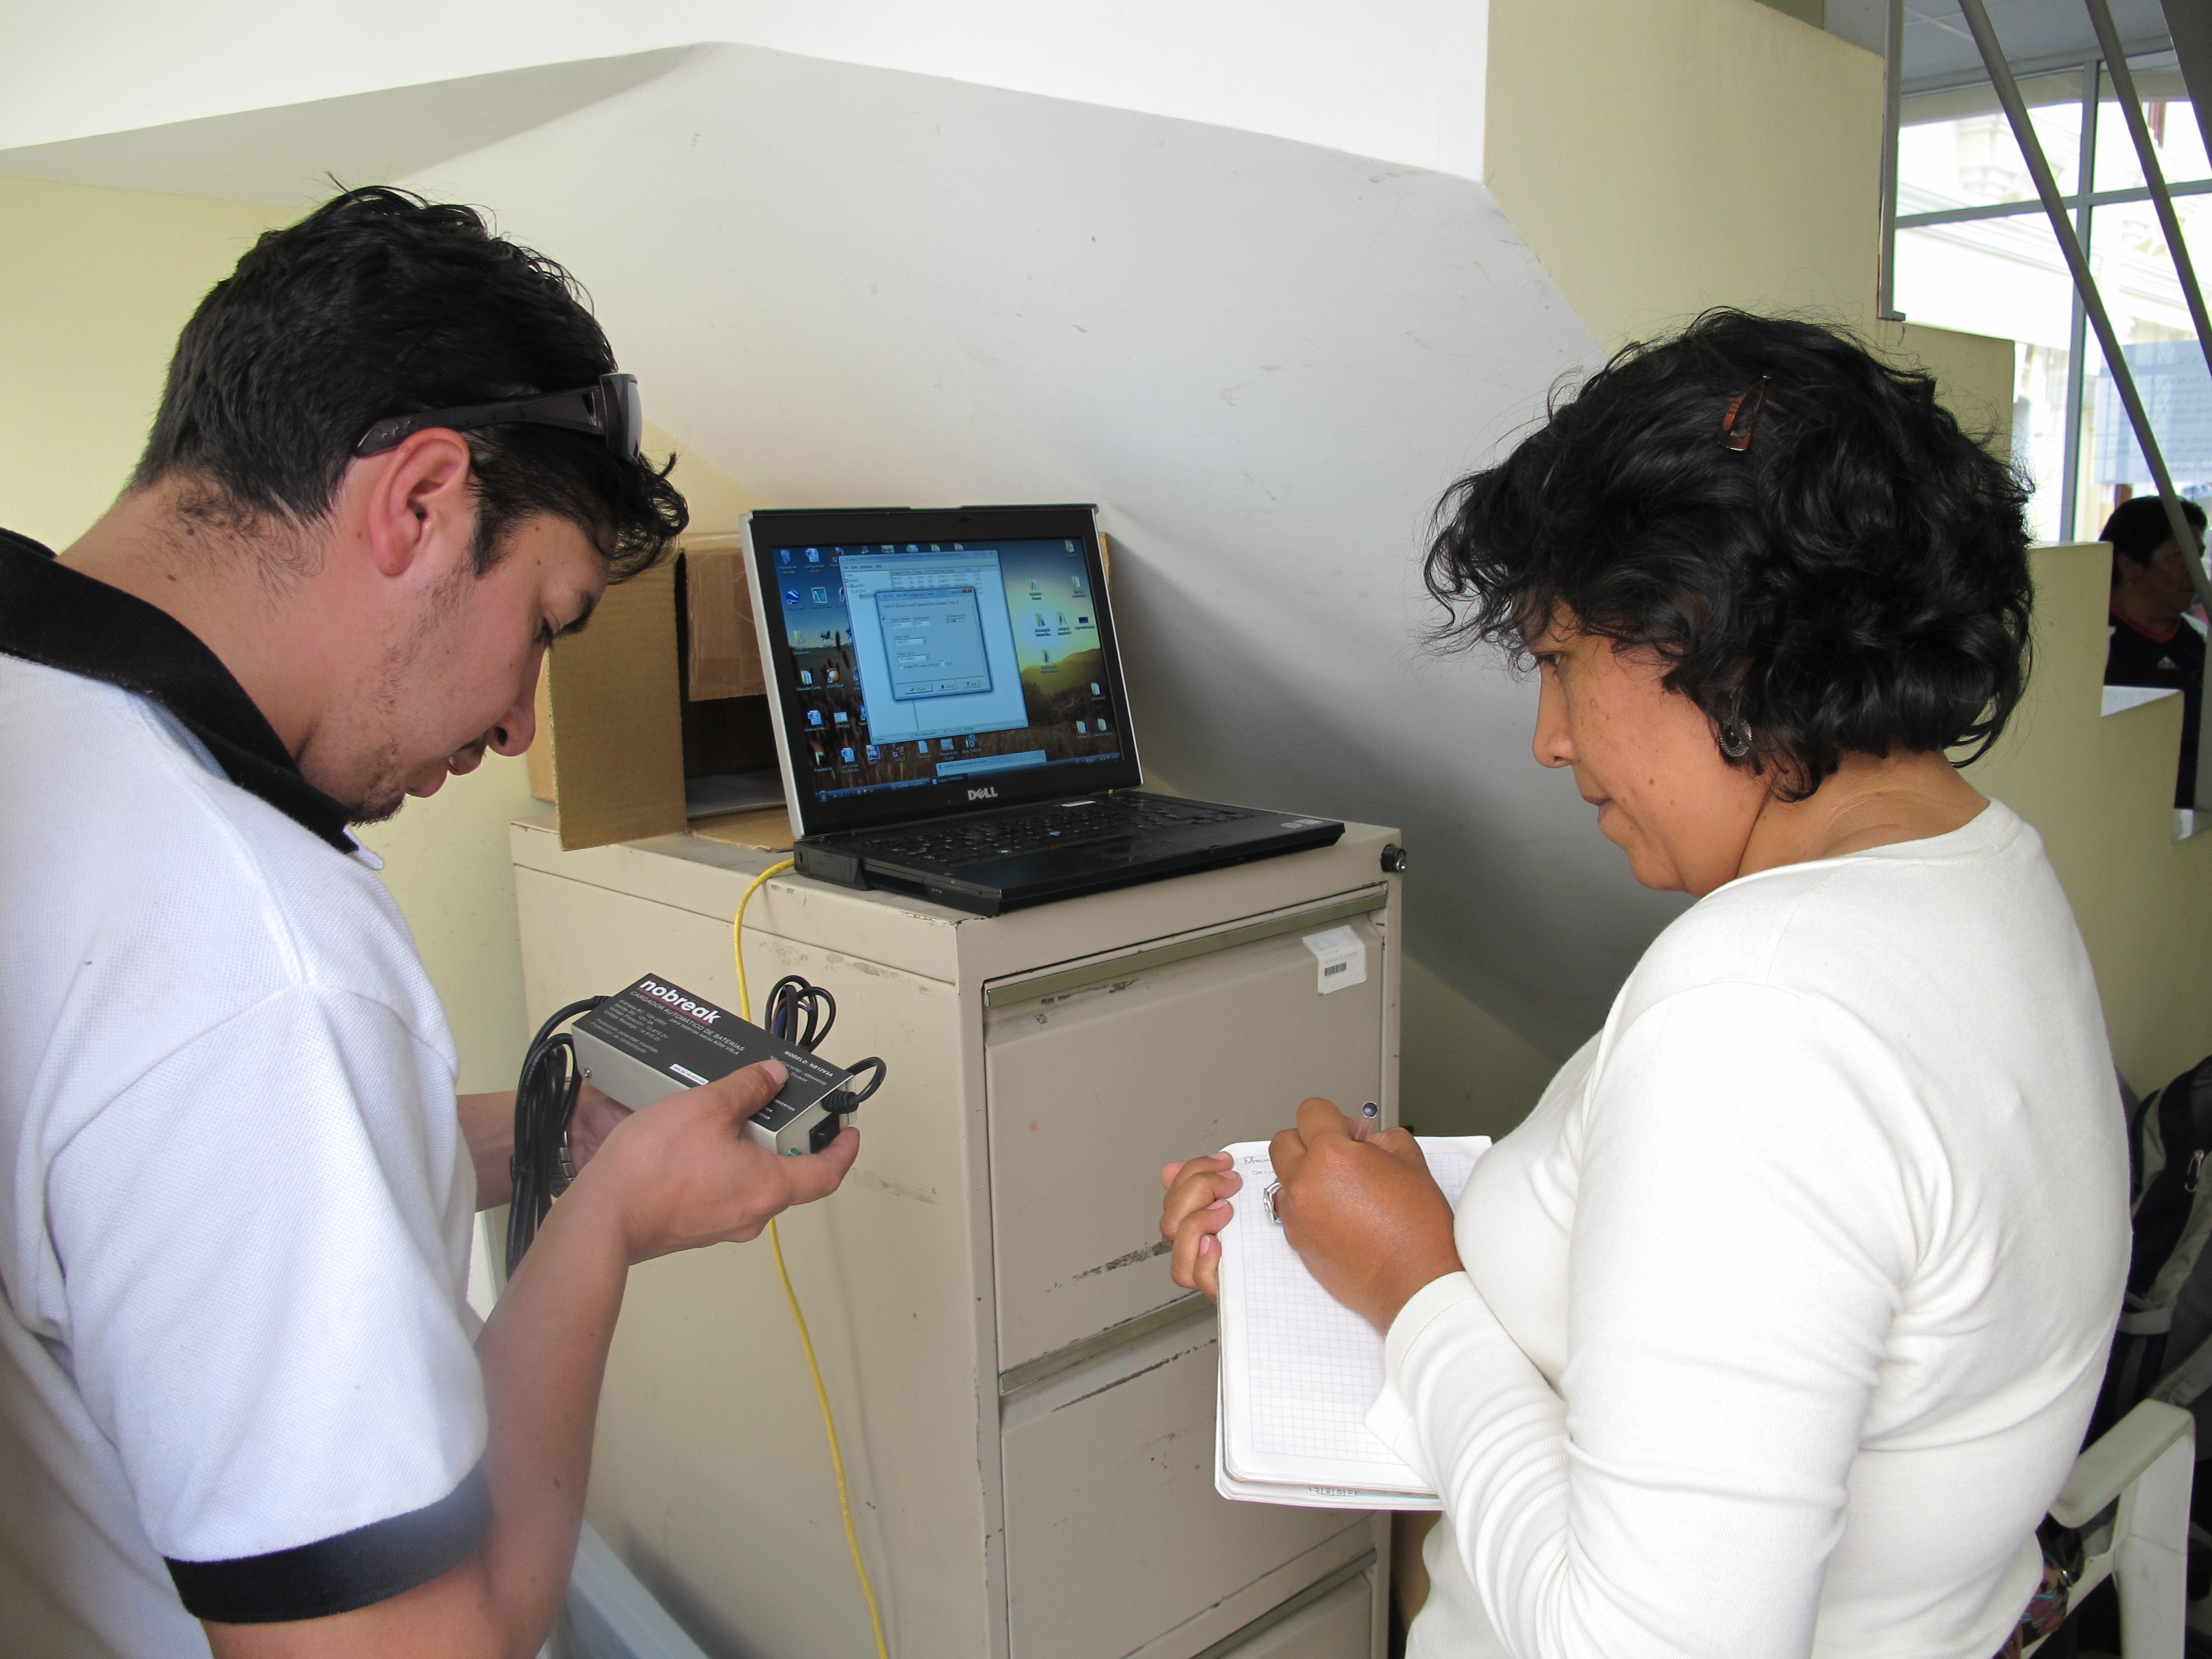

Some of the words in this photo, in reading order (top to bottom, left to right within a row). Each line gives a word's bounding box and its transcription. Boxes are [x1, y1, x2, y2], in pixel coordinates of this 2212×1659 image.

[967, 787, 998, 800] DELL
[630, 991, 665, 1010] CARGADOR
[663, 1007, 706, 1030] AUTOMÁTICO
[713, 1033, 746, 1051] BATERÍAS
[640, 980, 722, 1024] nobreak
